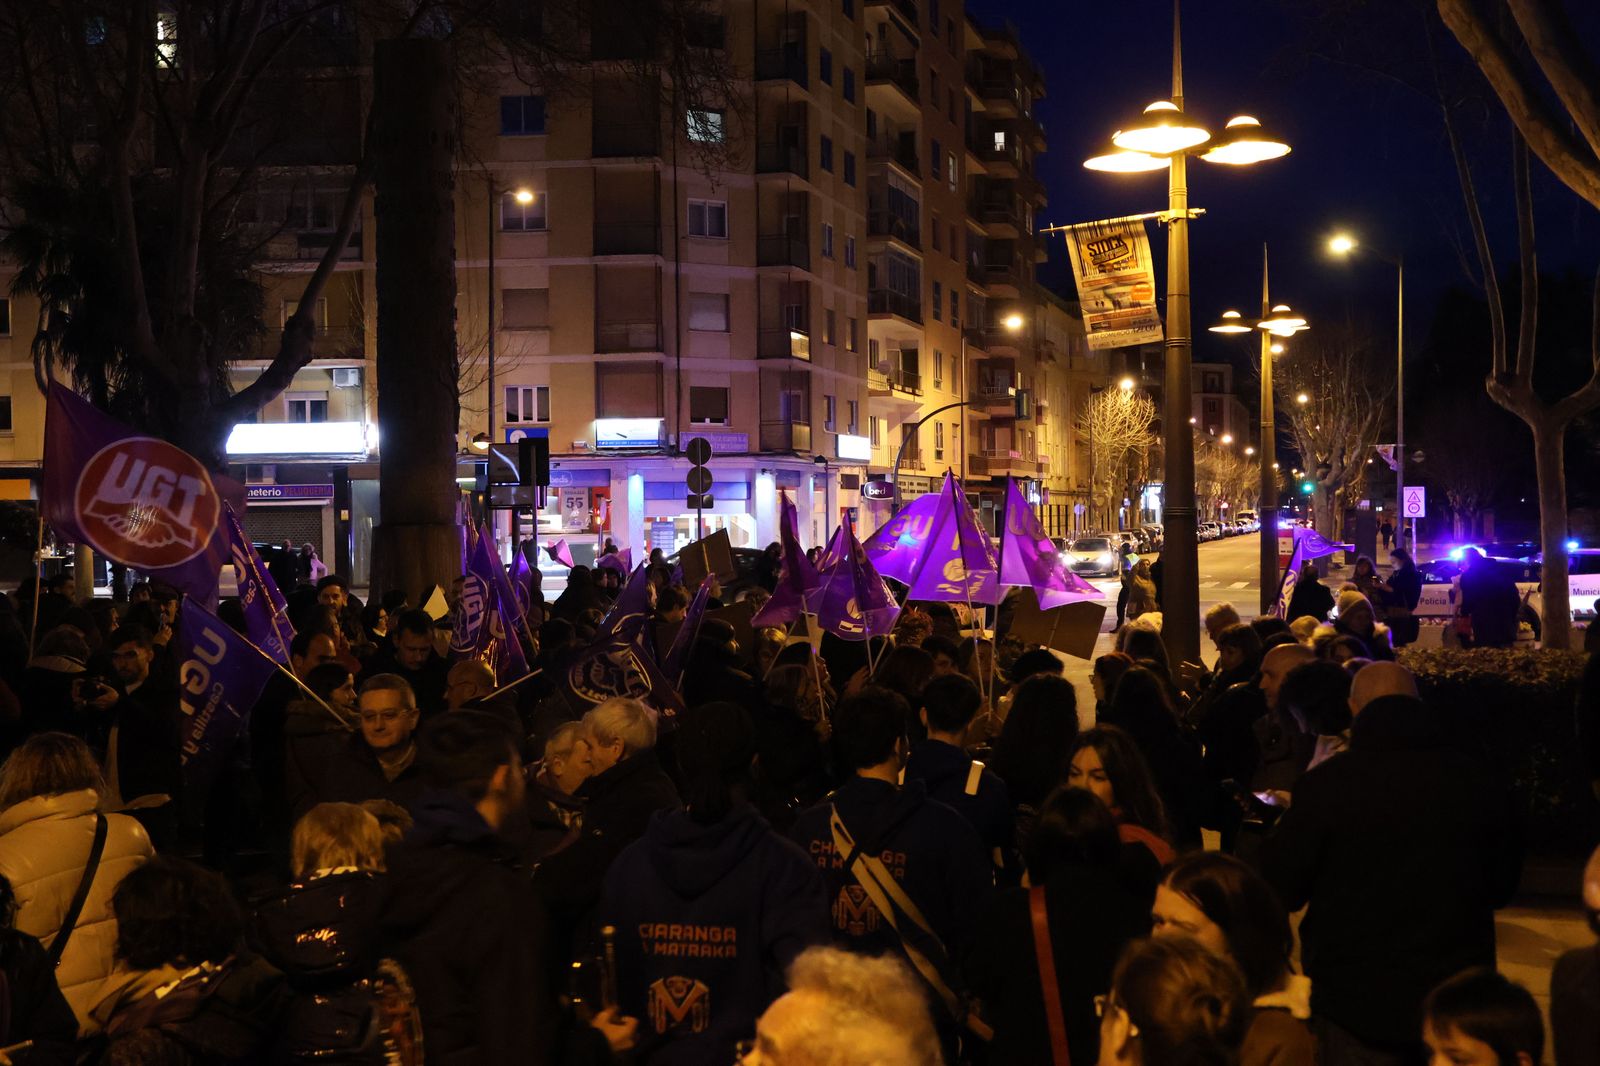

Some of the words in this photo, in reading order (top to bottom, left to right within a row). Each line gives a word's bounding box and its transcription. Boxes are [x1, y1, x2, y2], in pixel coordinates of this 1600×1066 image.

[1087, 234, 1126, 257] STOCK
[97, 452, 206, 530] UGT
[654, 942, 737, 959] MATRAKA
